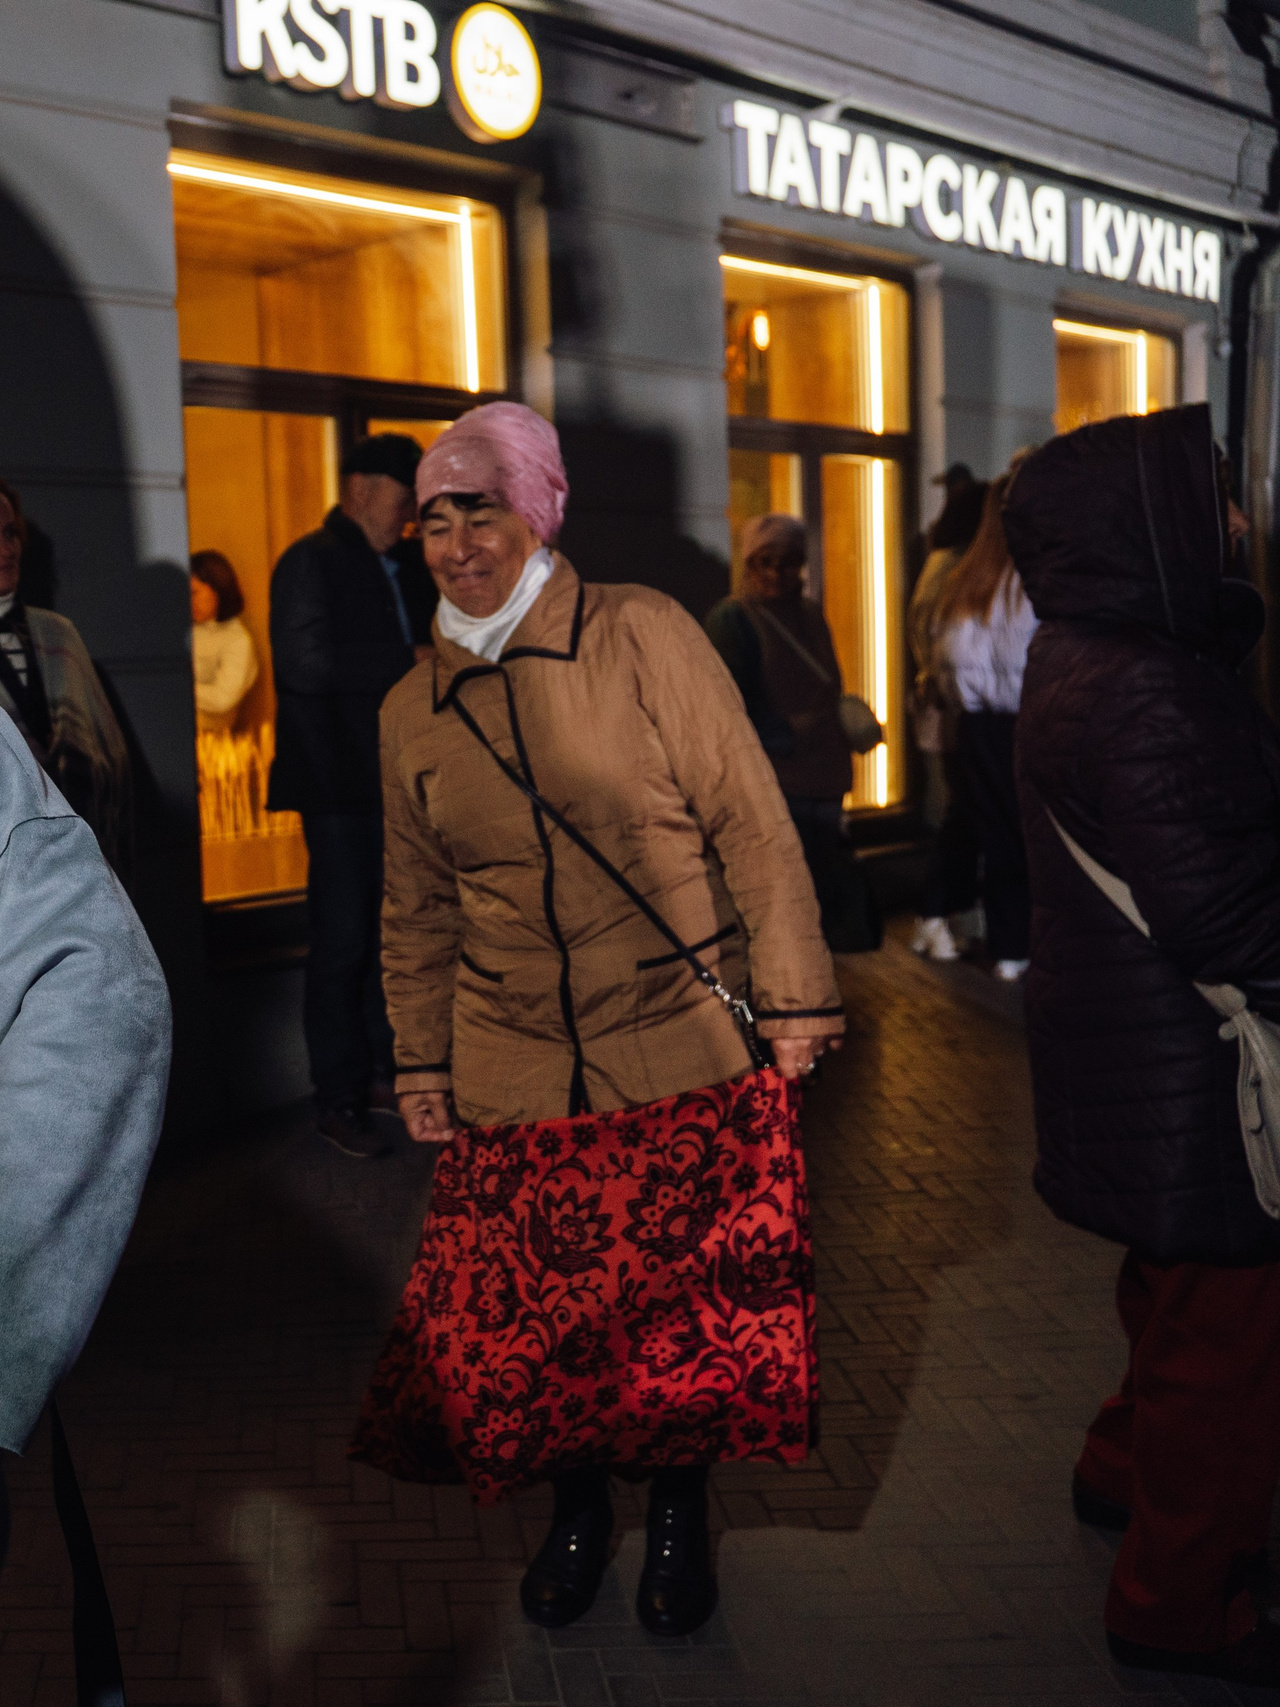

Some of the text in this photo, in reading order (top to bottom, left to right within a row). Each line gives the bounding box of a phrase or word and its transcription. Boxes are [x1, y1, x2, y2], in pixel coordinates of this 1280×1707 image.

[232, 0, 441, 108] KSTB
[733, 100, 1221, 303] ТАТАРСКАЯ КУХНЯ
